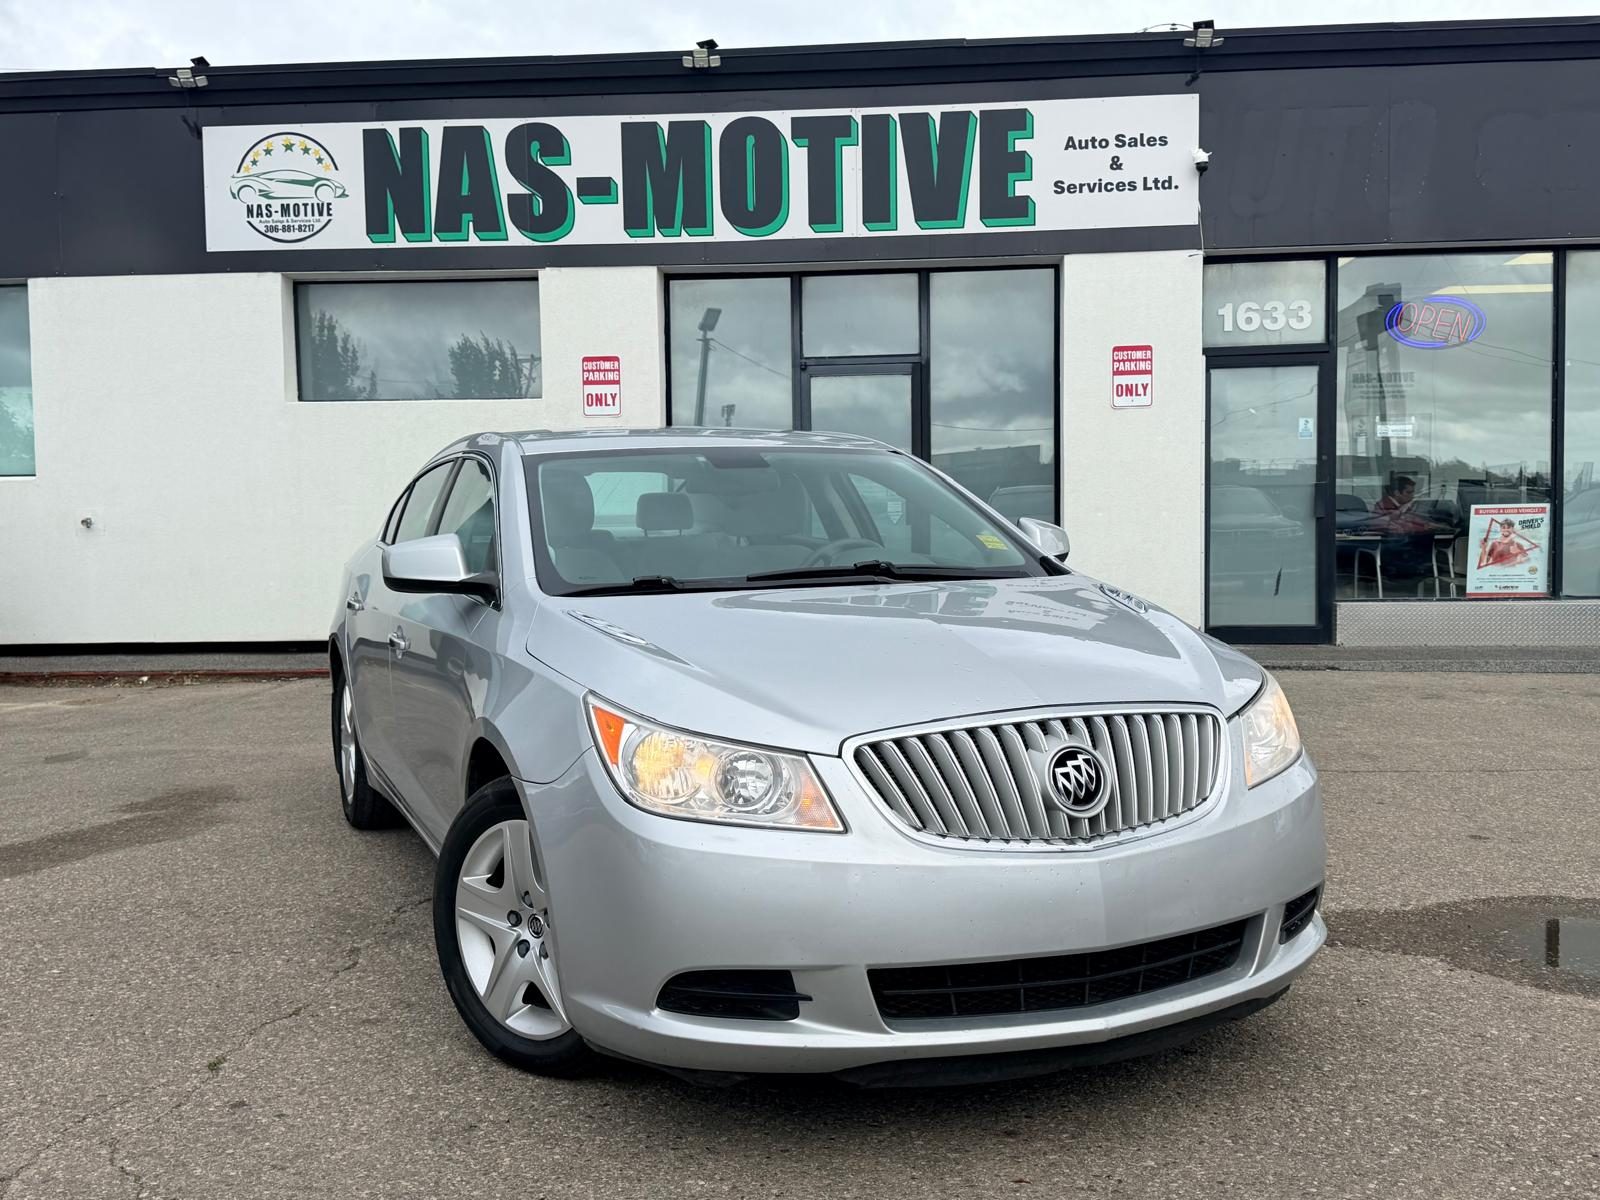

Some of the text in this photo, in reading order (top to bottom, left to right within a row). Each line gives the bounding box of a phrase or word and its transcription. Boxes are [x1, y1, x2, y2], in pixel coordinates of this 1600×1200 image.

[1064, 133, 1168, 151] Auto Sales
[1109, 155, 1123, 170] &
[362, 107, 1036, 243] NAS-MOTIVE
[1053, 176, 1179, 194] Services Ltd.
[246, 202, 333, 219] NAS-MOTIVE
[264, 224, 315, 233] 306-881-8217
[1217, 301, 1312, 332] 1633
[1397, 302, 1472, 341] OPEN
[1113, 350, 1151, 361] CUSTOMER
[583, 361, 619, 370] CUSTOMER
[1113, 360, 1152, 371] PARKING
[583, 371, 619, 381] PARKING
[1116, 383, 1149, 397] ONLY
[586, 393, 617, 407] ONLY
[1518, 517, 1545, 526] DRIVER'S
